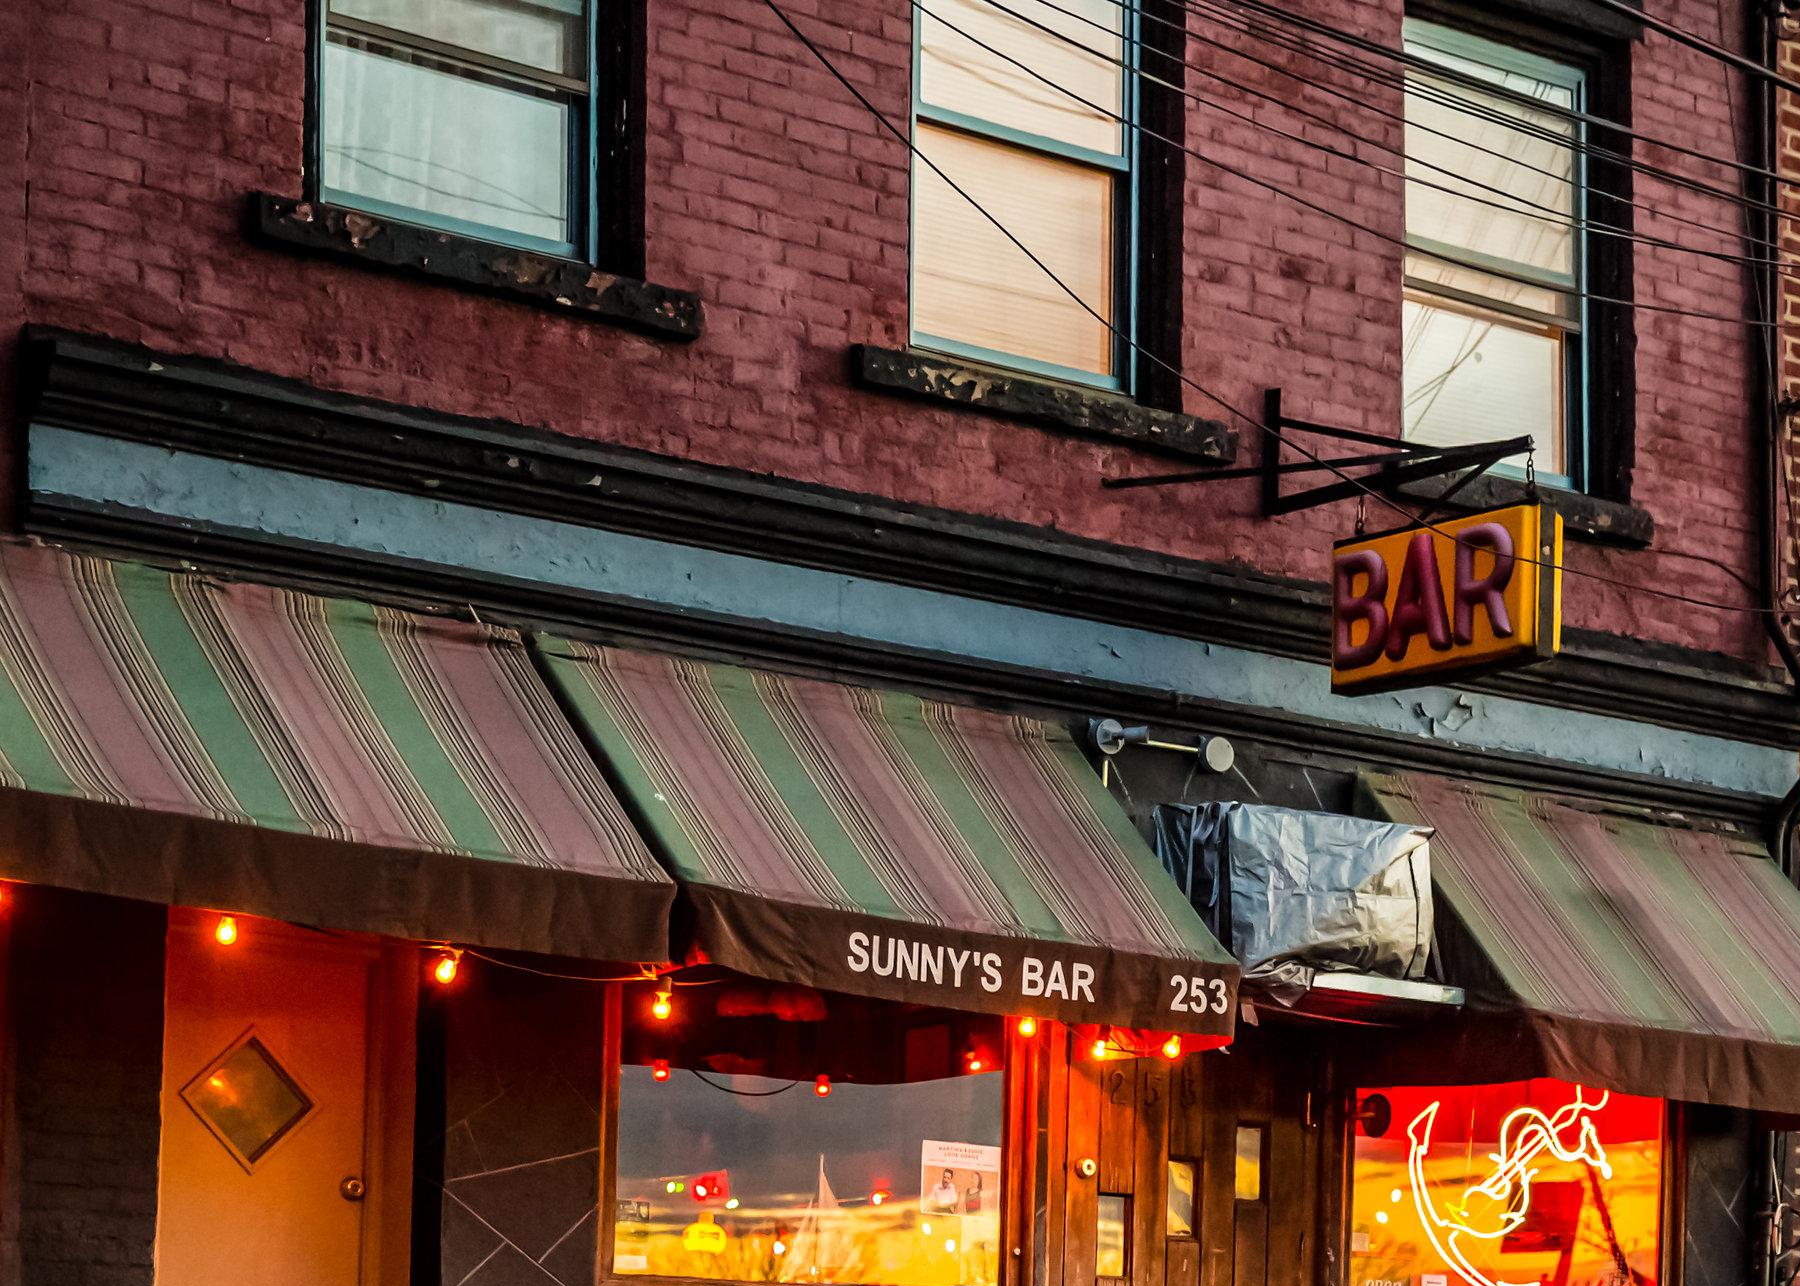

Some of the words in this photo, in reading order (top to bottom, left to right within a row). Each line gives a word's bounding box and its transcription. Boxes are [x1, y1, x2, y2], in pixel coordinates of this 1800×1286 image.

[1335, 522, 1514, 671] BAR
[846, 931, 1003, 993] SUNNY'S
[1021, 957, 1096, 1003] BAR
[1169, 974, 1228, 1015] 253
